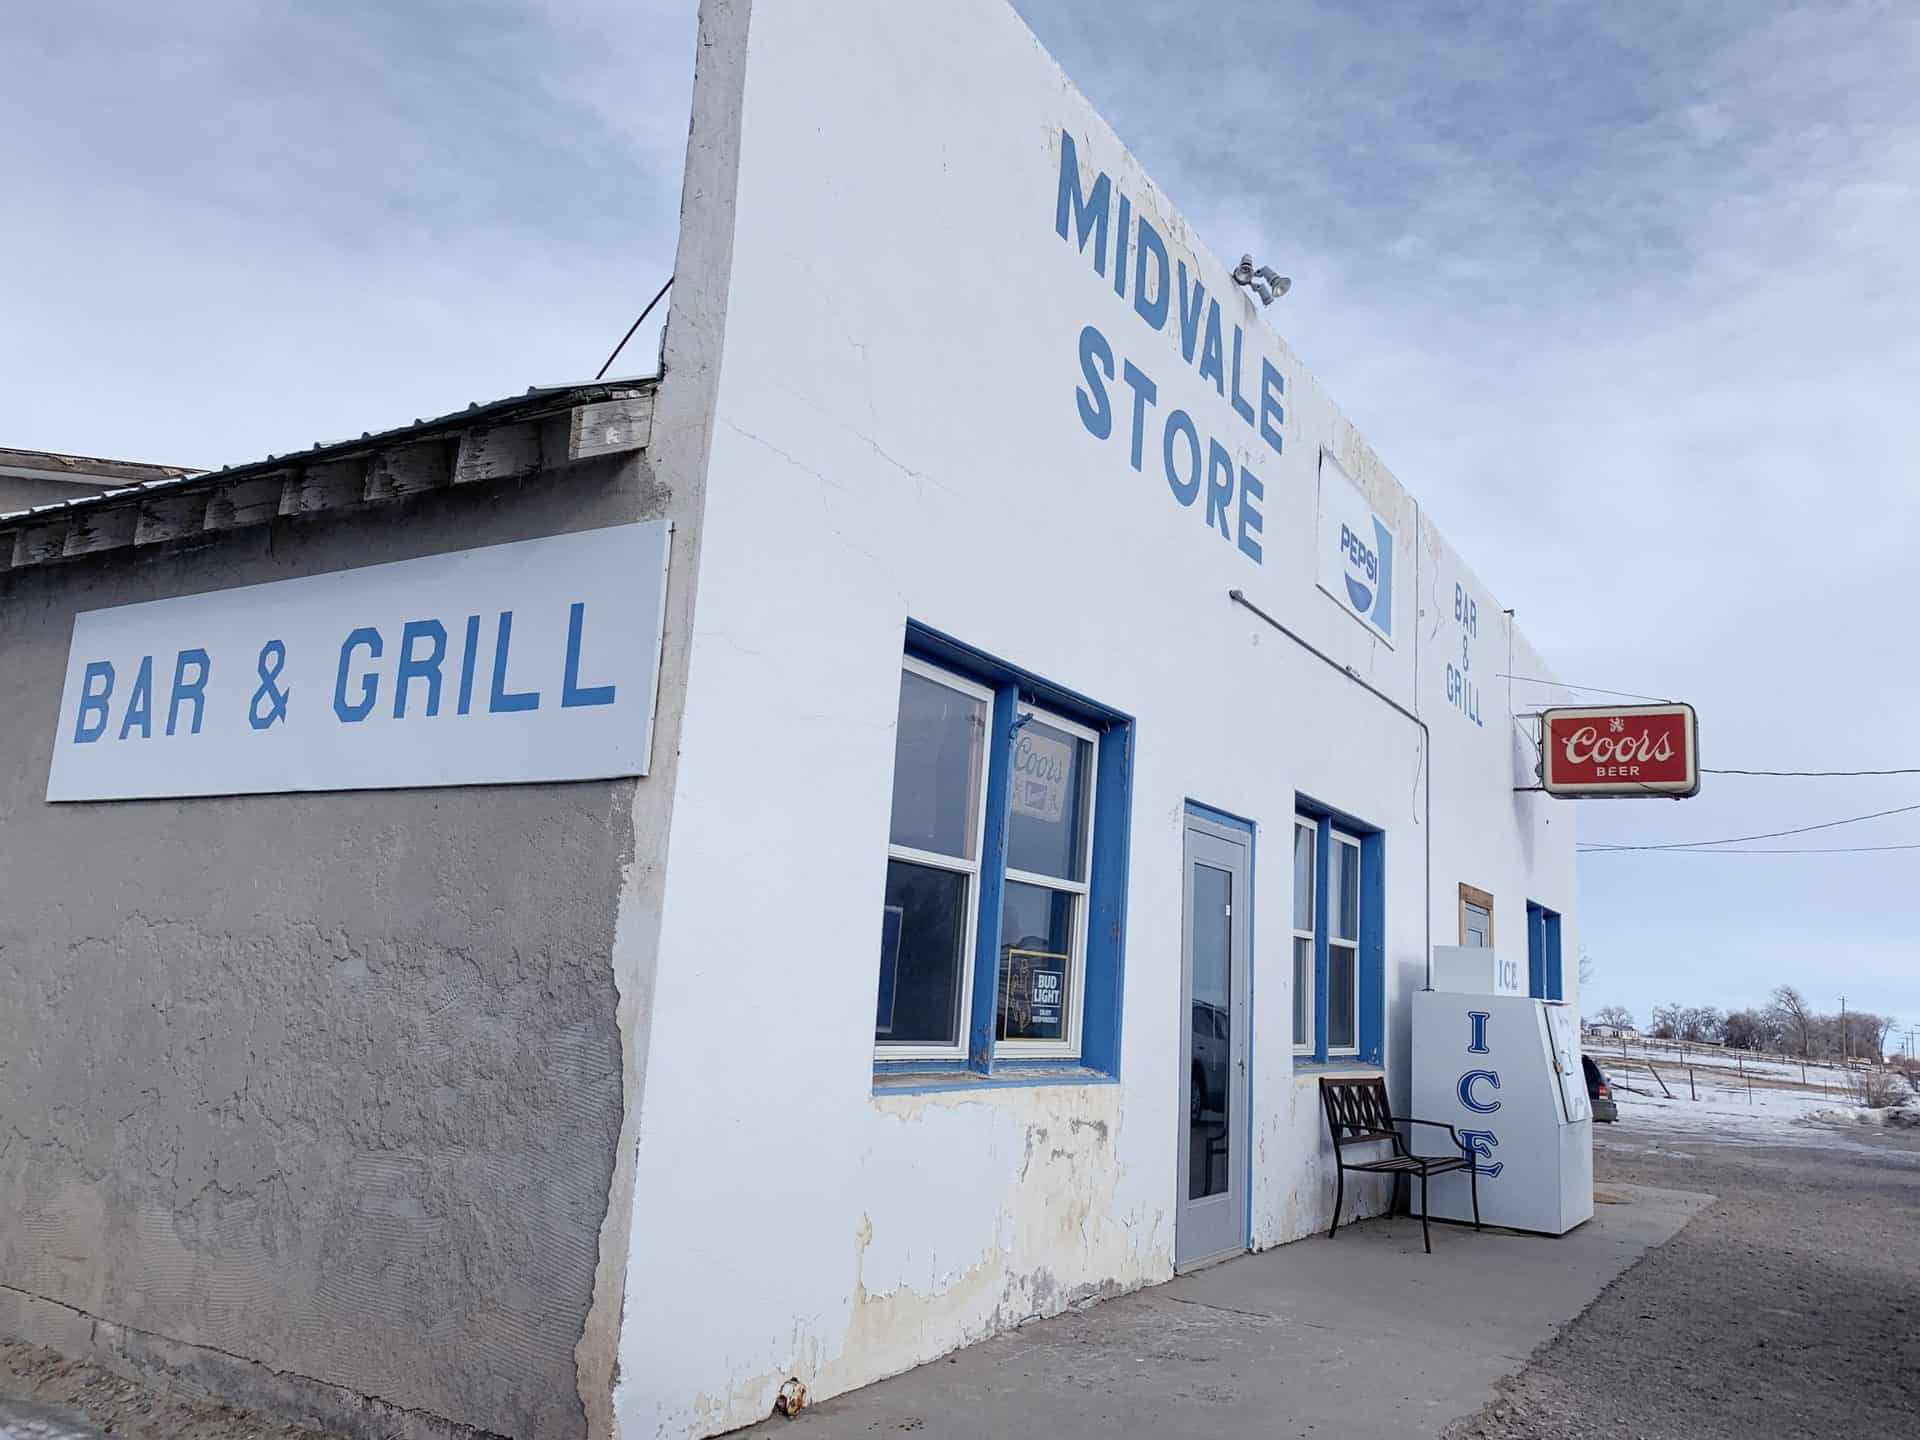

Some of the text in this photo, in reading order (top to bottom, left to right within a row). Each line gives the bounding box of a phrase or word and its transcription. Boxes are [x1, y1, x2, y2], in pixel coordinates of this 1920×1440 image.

[1055, 127, 1285, 456] MIDVALE
[1075, 324, 1264, 566] STORE
[1340, 522, 1378, 585] PEPSI
[1455, 581, 1477, 639] BAR
[73, 602, 617, 744] BAR & GRILL
[1462, 634, 1469, 672] &
[1446, 662, 1483, 728] GRILL
[1014, 736, 1063, 784] Coors
[1561, 726, 1675, 765] Coors
[1596, 766, 1640, 777] BEER
[1033, 988, 1060, 1003] LIGHT
[1037, 974, 1057, 989] BUD
[1498, 959, 1519, 990] ICE
[1457, 1011, 1504, 1178] ICE
